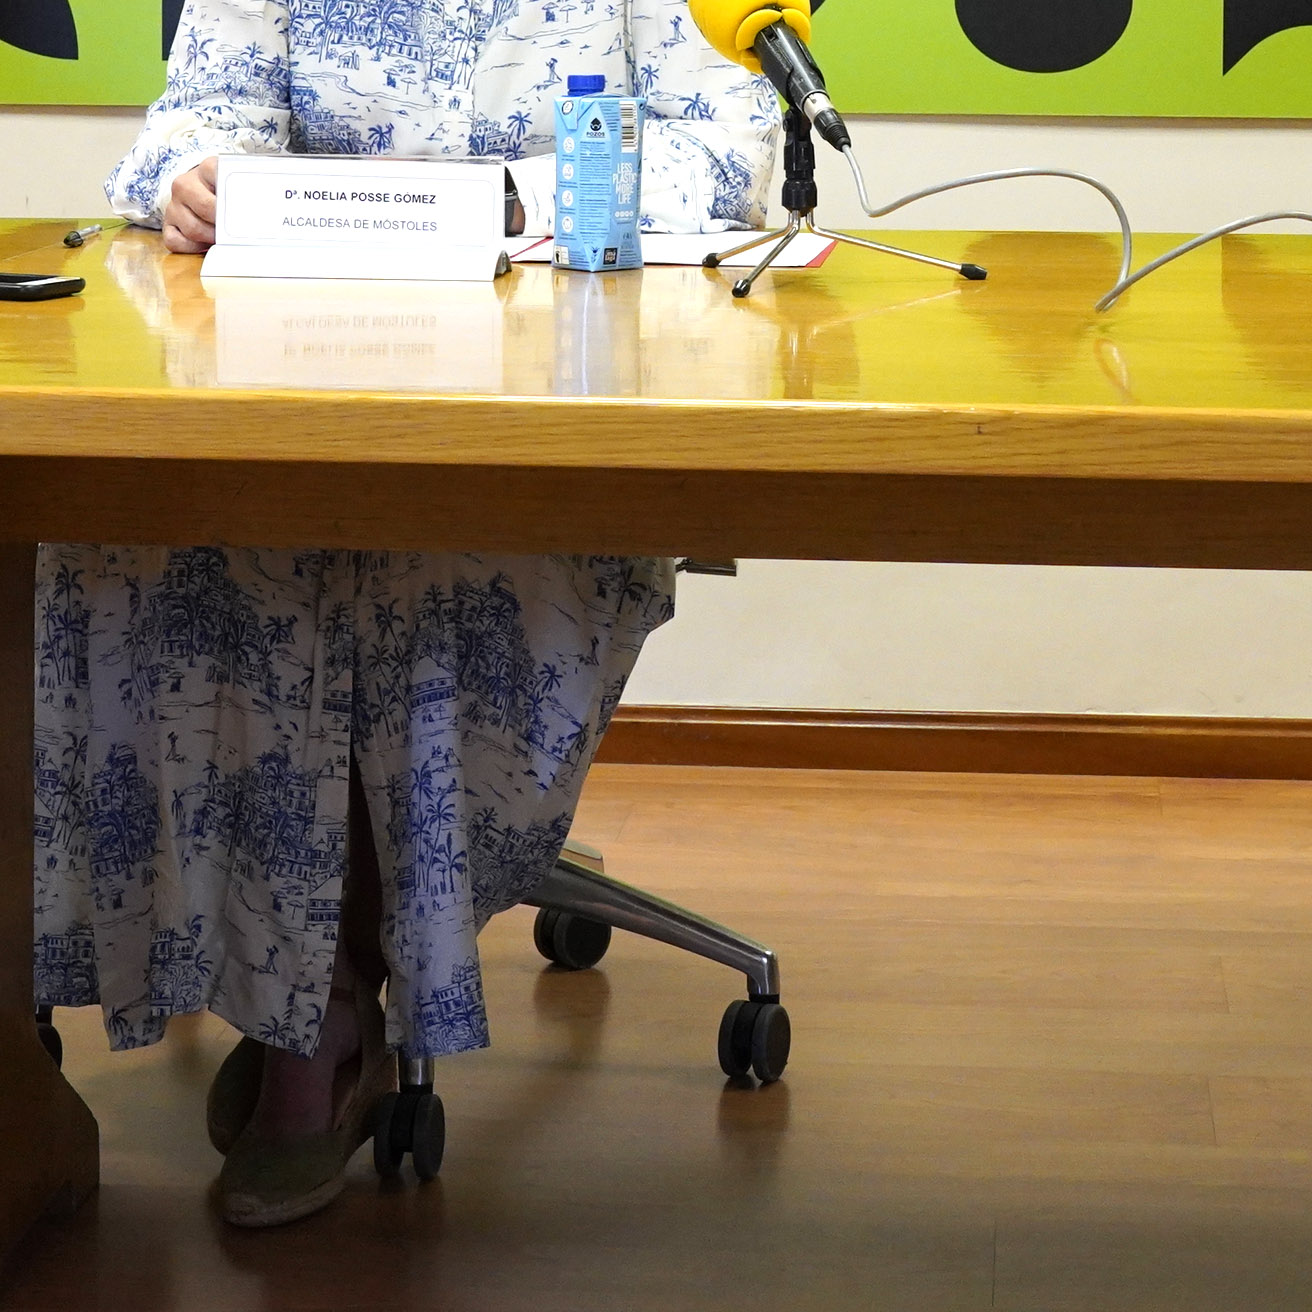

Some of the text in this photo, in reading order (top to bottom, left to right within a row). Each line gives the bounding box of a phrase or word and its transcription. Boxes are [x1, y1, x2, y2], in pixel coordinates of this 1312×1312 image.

[617, 163, 633, 173] LESS
[612, 172, 637, 184] PLASTIC
[615, 183, 634, 195] MORE
[304, 190, 347, 201] NOELIA
[351, 192, 390, 203] POSSE
[394, 191, 437, 204] GÓMEZ
[618, 194, 632, 204] LIFE
[282, 217, 438, 232] ALCALDESA DE MÓSTOLES
